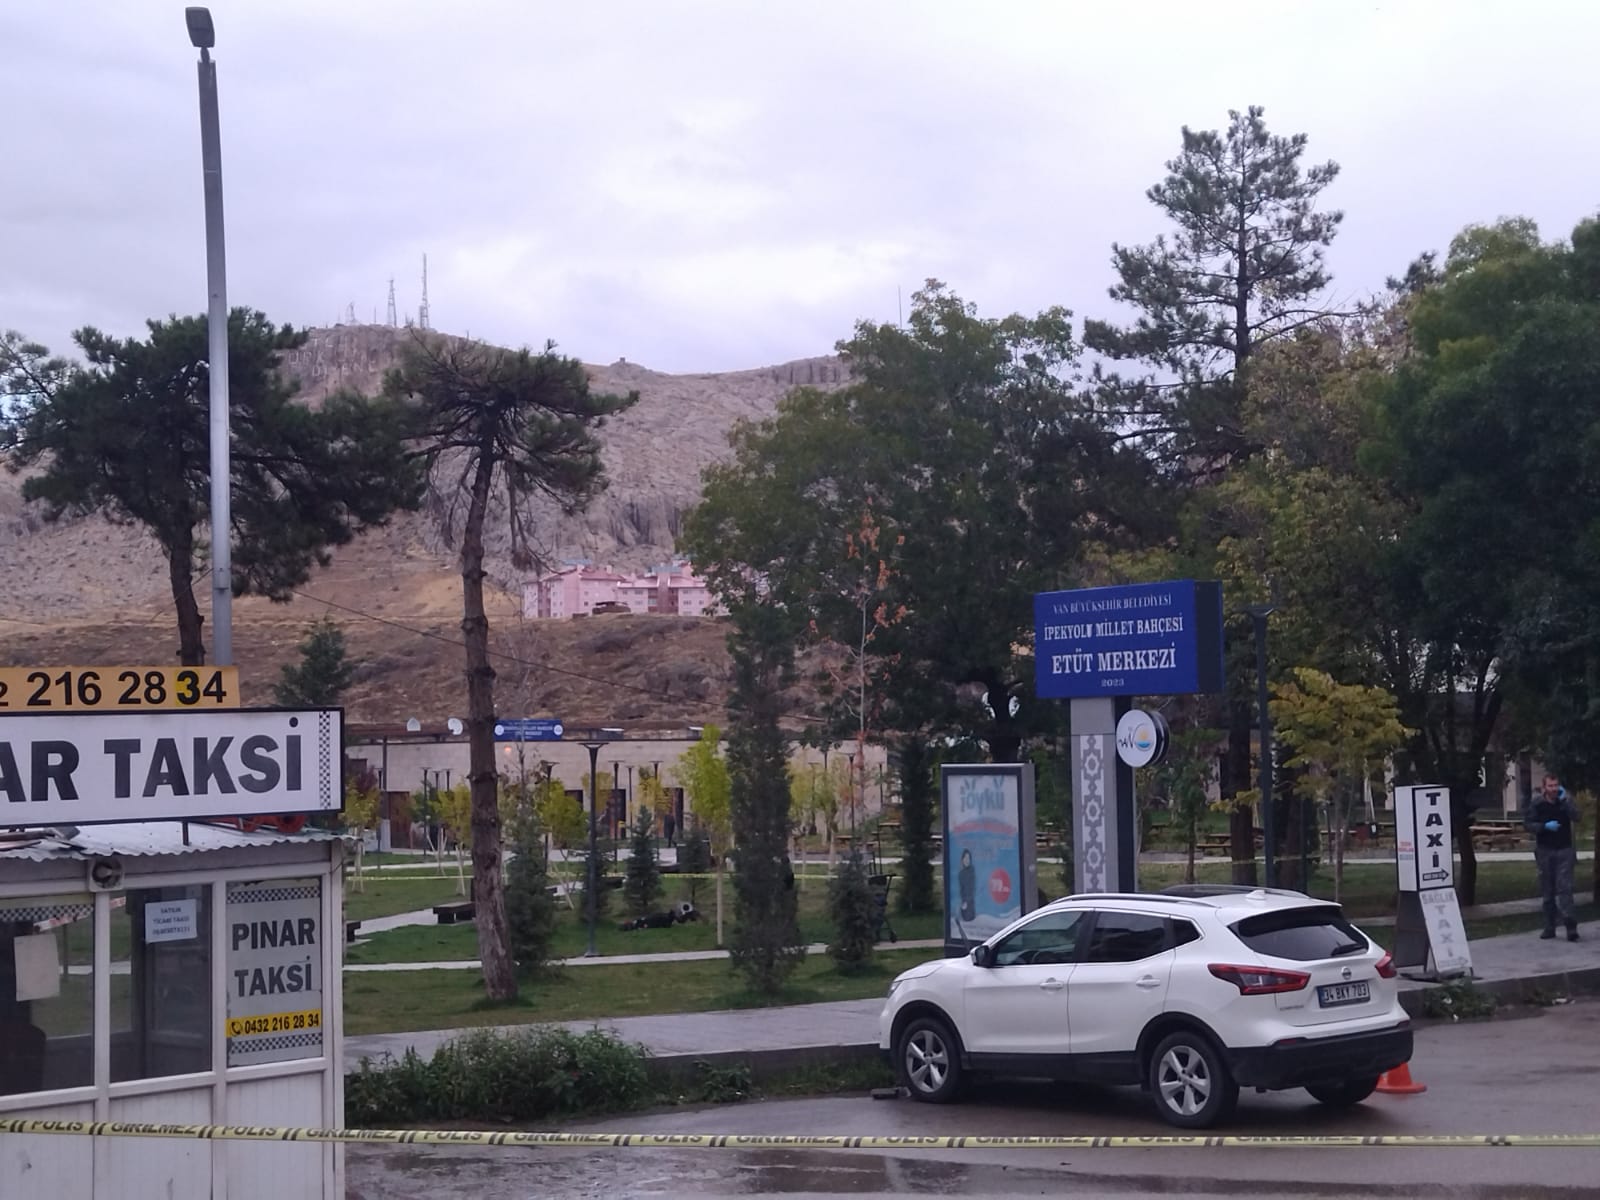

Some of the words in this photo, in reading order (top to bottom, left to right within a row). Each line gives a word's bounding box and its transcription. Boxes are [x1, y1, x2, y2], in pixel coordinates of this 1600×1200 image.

[1095, 618, 1134, 637] MİLLET
[1137, 612, 1184, 637] BAHÇESİ
[1052, 648, 1093, 675] ETÜT
[1098, 641, 1177, 672] MERKEZİ
[27, 671, 102, 706] 216
[103, 716, 303, 799] TAKSİ
[232, 917, 316, 951] PINAR
[234, 955, 313, 997] TAKSİ
[1323, 987, 1334, 1001] 34
[244, 1018, 269, 1034] 0432
[272, 1015, 290, 1031] 216
[293, 1014, 305, 1029] 28
[307, 1012, 319, 1028] 34
